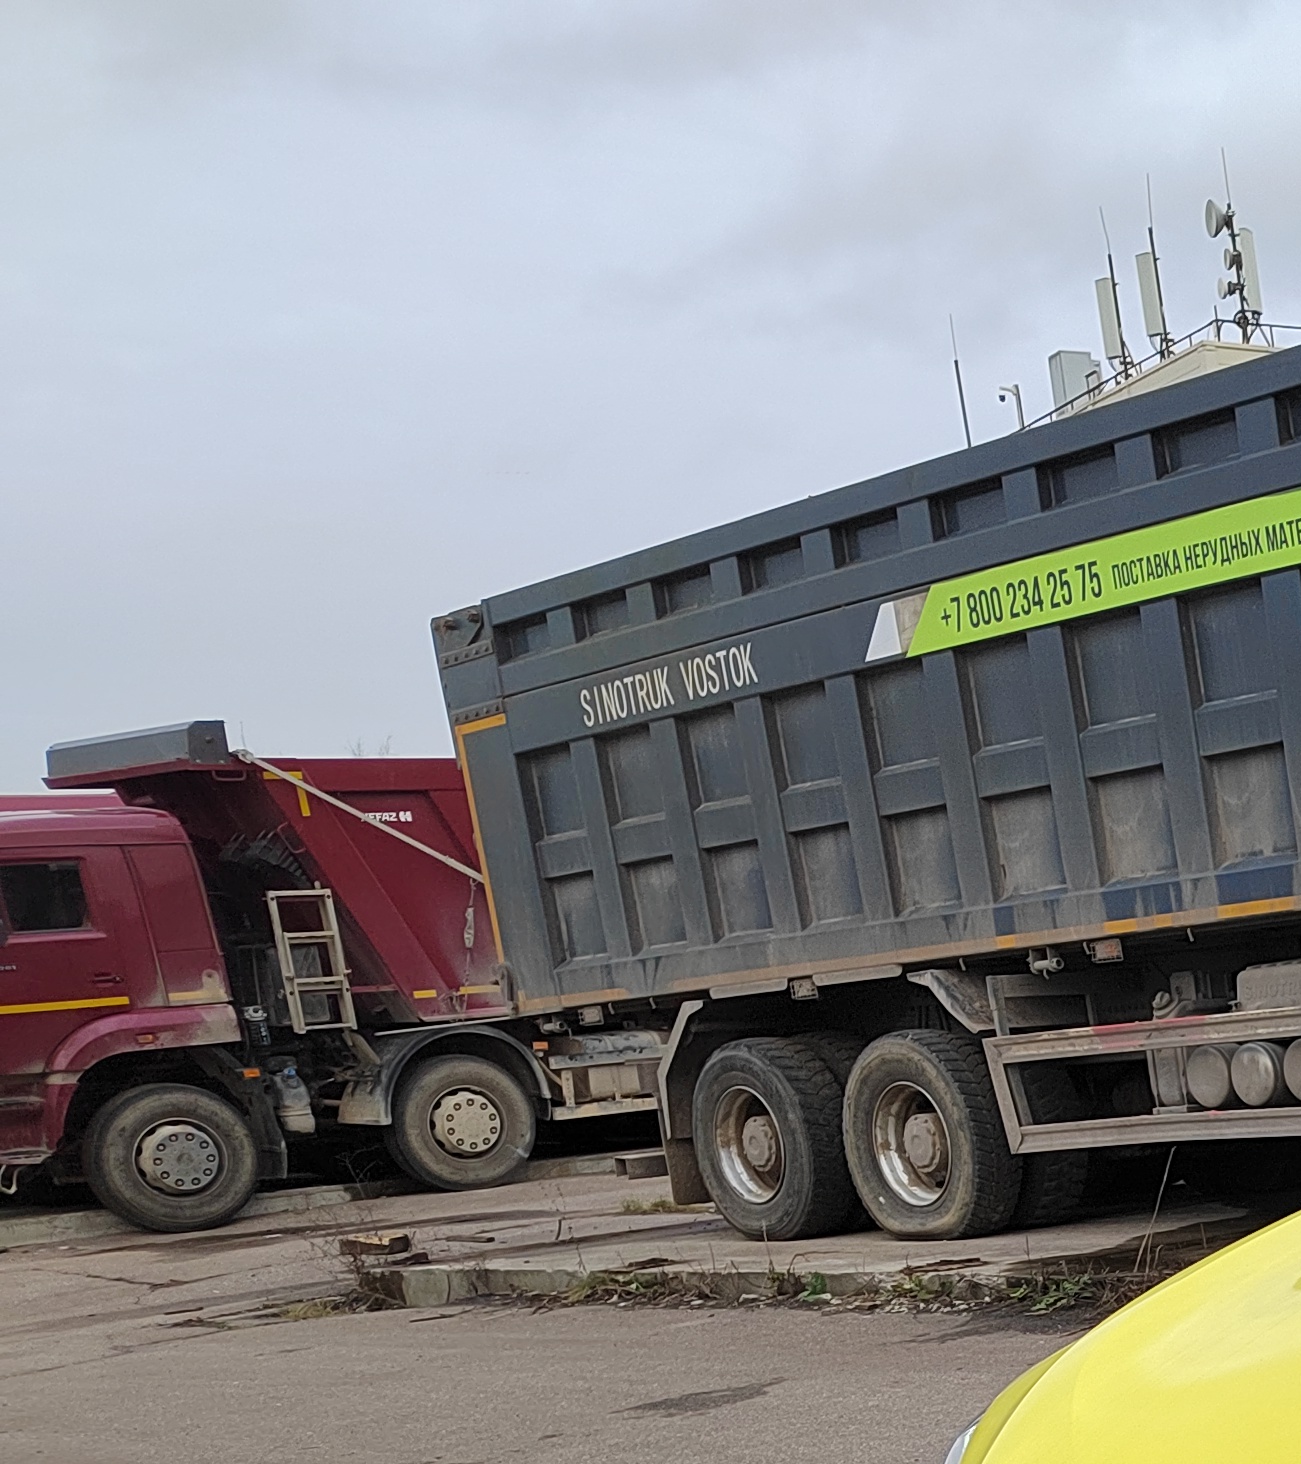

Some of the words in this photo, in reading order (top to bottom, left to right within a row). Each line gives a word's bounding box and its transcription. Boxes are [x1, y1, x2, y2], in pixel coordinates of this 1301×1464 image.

[940, 595, 962, 633] +7
[968, 586, 1003, 629] 800
[1005, 575, 1045, 620] 234
[1046, 567, 1074, 610] 25
[1074, 559, 1103, 603] 75
[1111, 550, 1183, 591] ПОСТАВКА
[1183, 528, 1264, 573] НЕРУДНЫХ
[579, 665, 675, 728] SINOTRUK
[679, 641, 759, 701] VOSTOK
[361, 811, 398, 823] EFAZ
